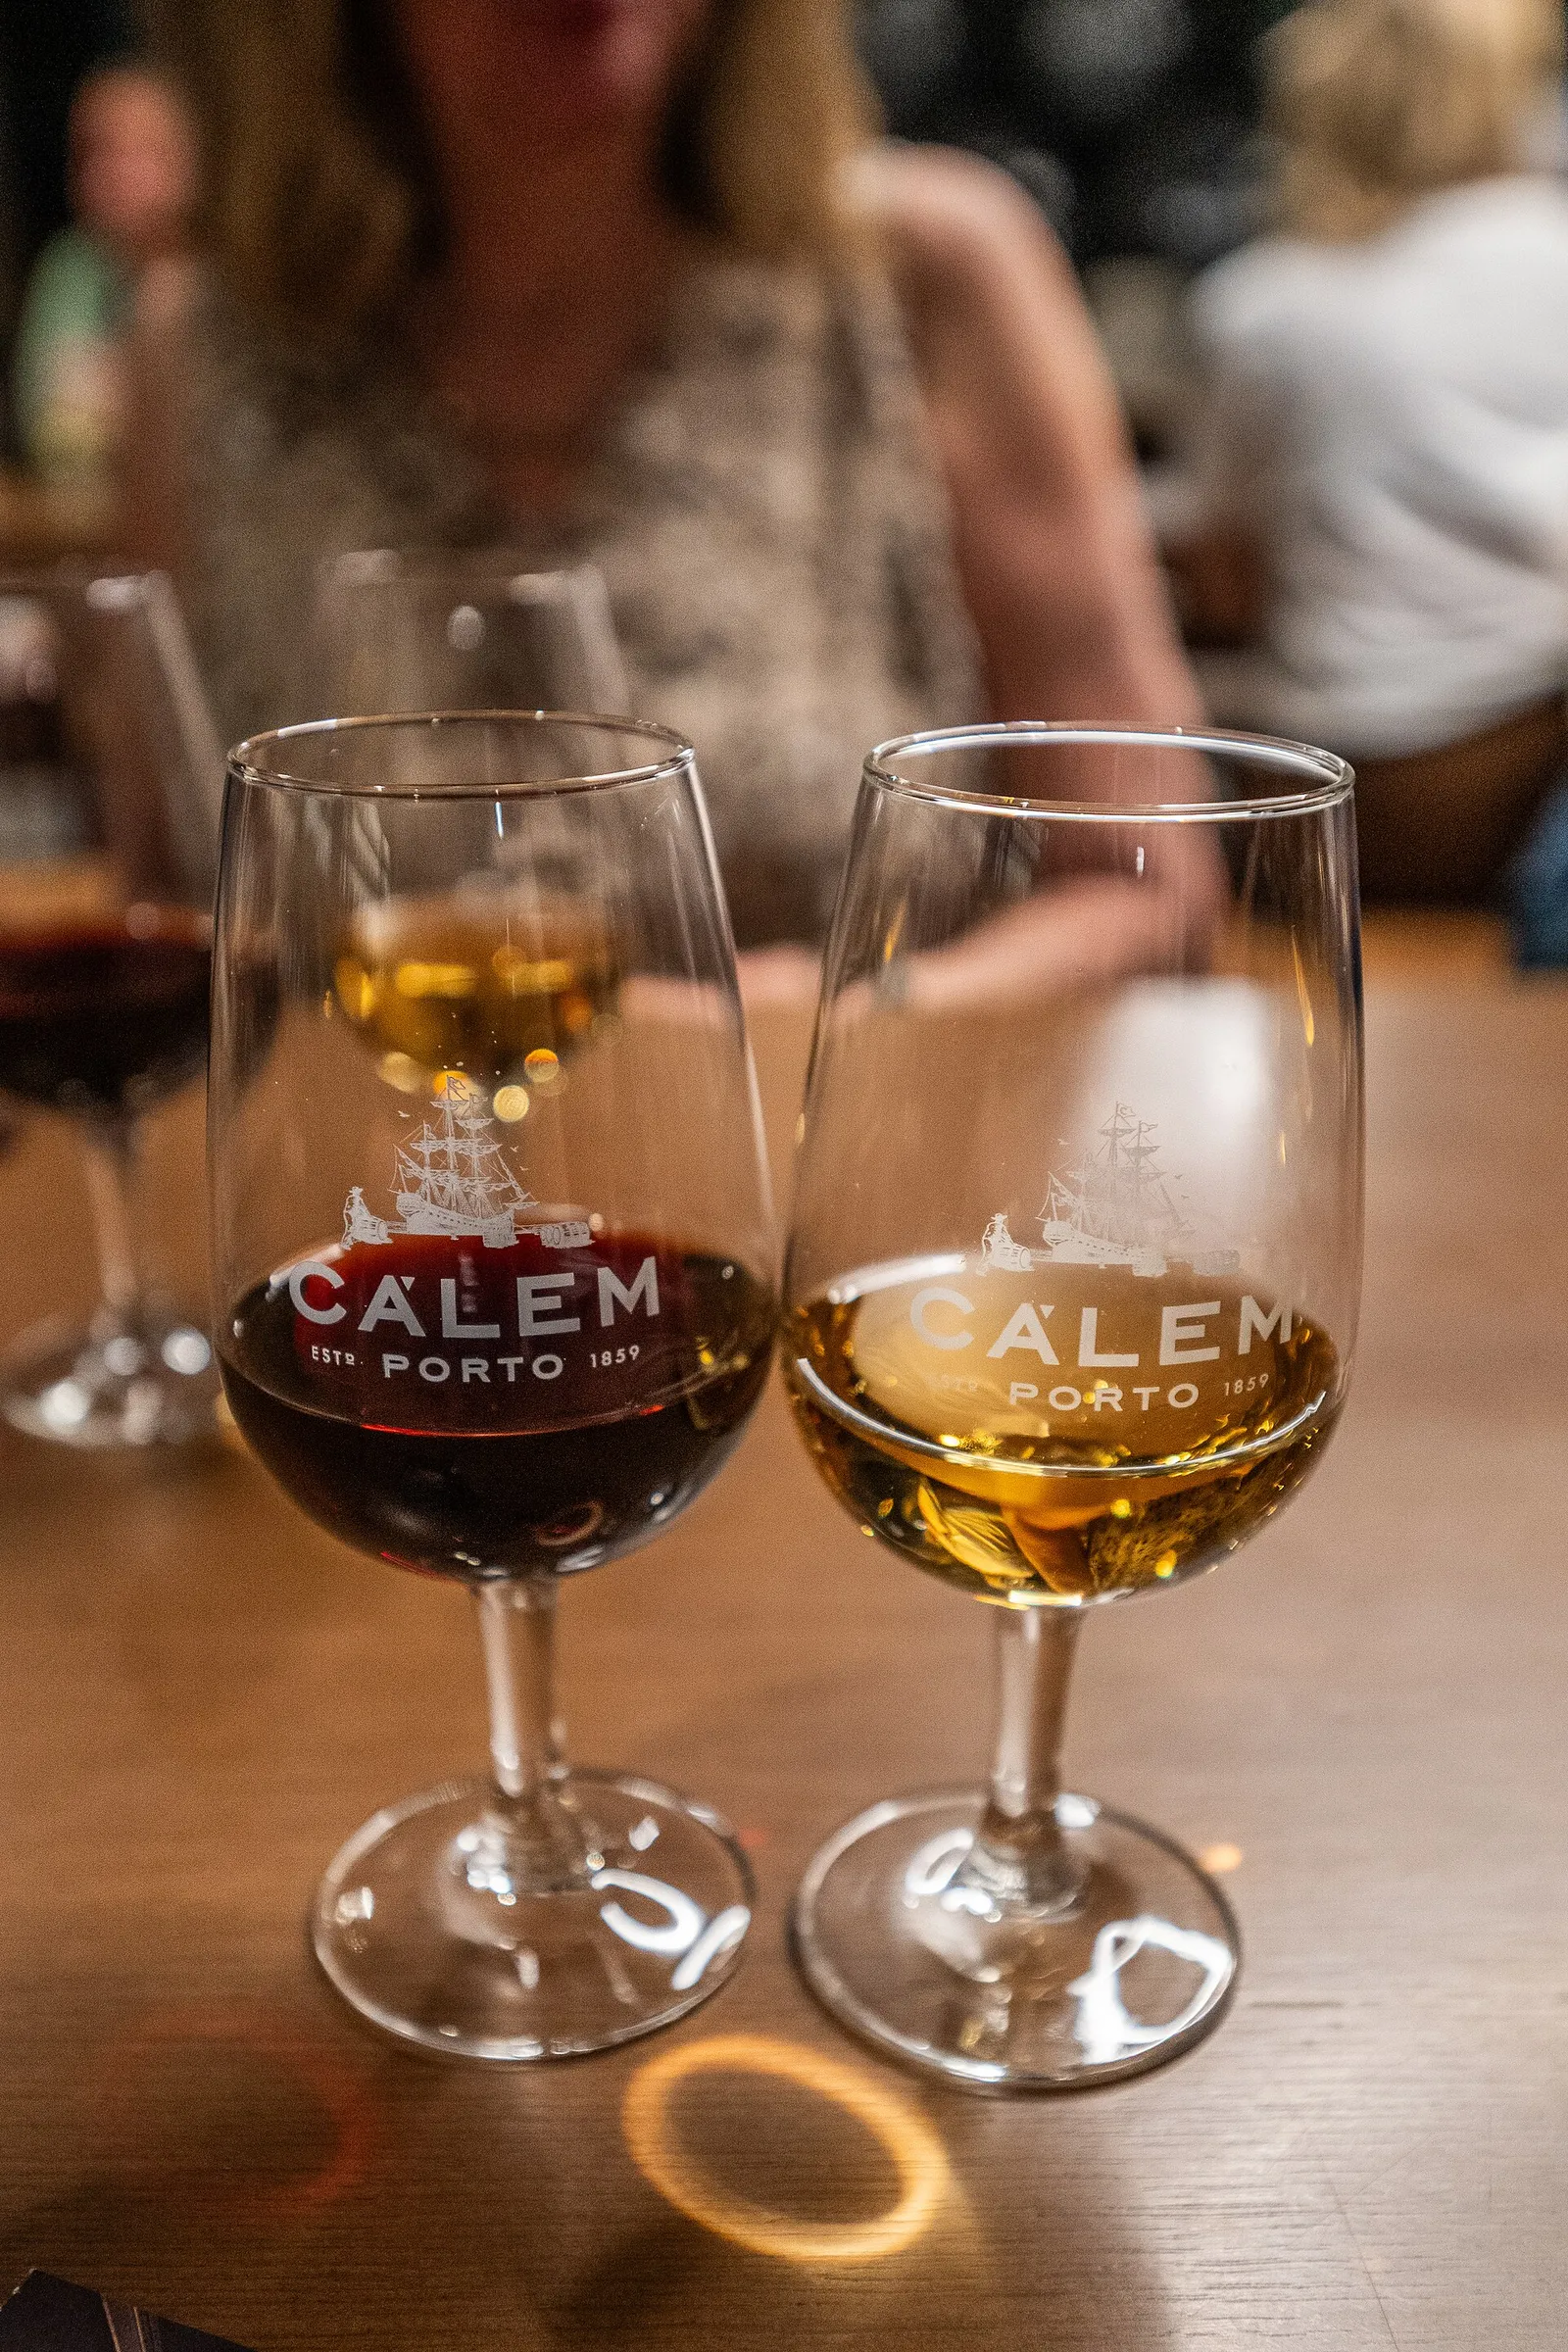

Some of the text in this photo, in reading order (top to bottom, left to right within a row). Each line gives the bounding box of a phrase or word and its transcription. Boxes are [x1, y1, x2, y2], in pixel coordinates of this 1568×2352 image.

[289, 1256, 661, 1338] CÁLEM
[909, 1287, 1293, 1368] CÁLEM
[382, 1353, 564, 1383] PORTO
[590, 1345, 641, 1368] 1859
[1008, 1382, 1200, 1412] PORTO
[1223, 1373, 1269, 1397] 1859
